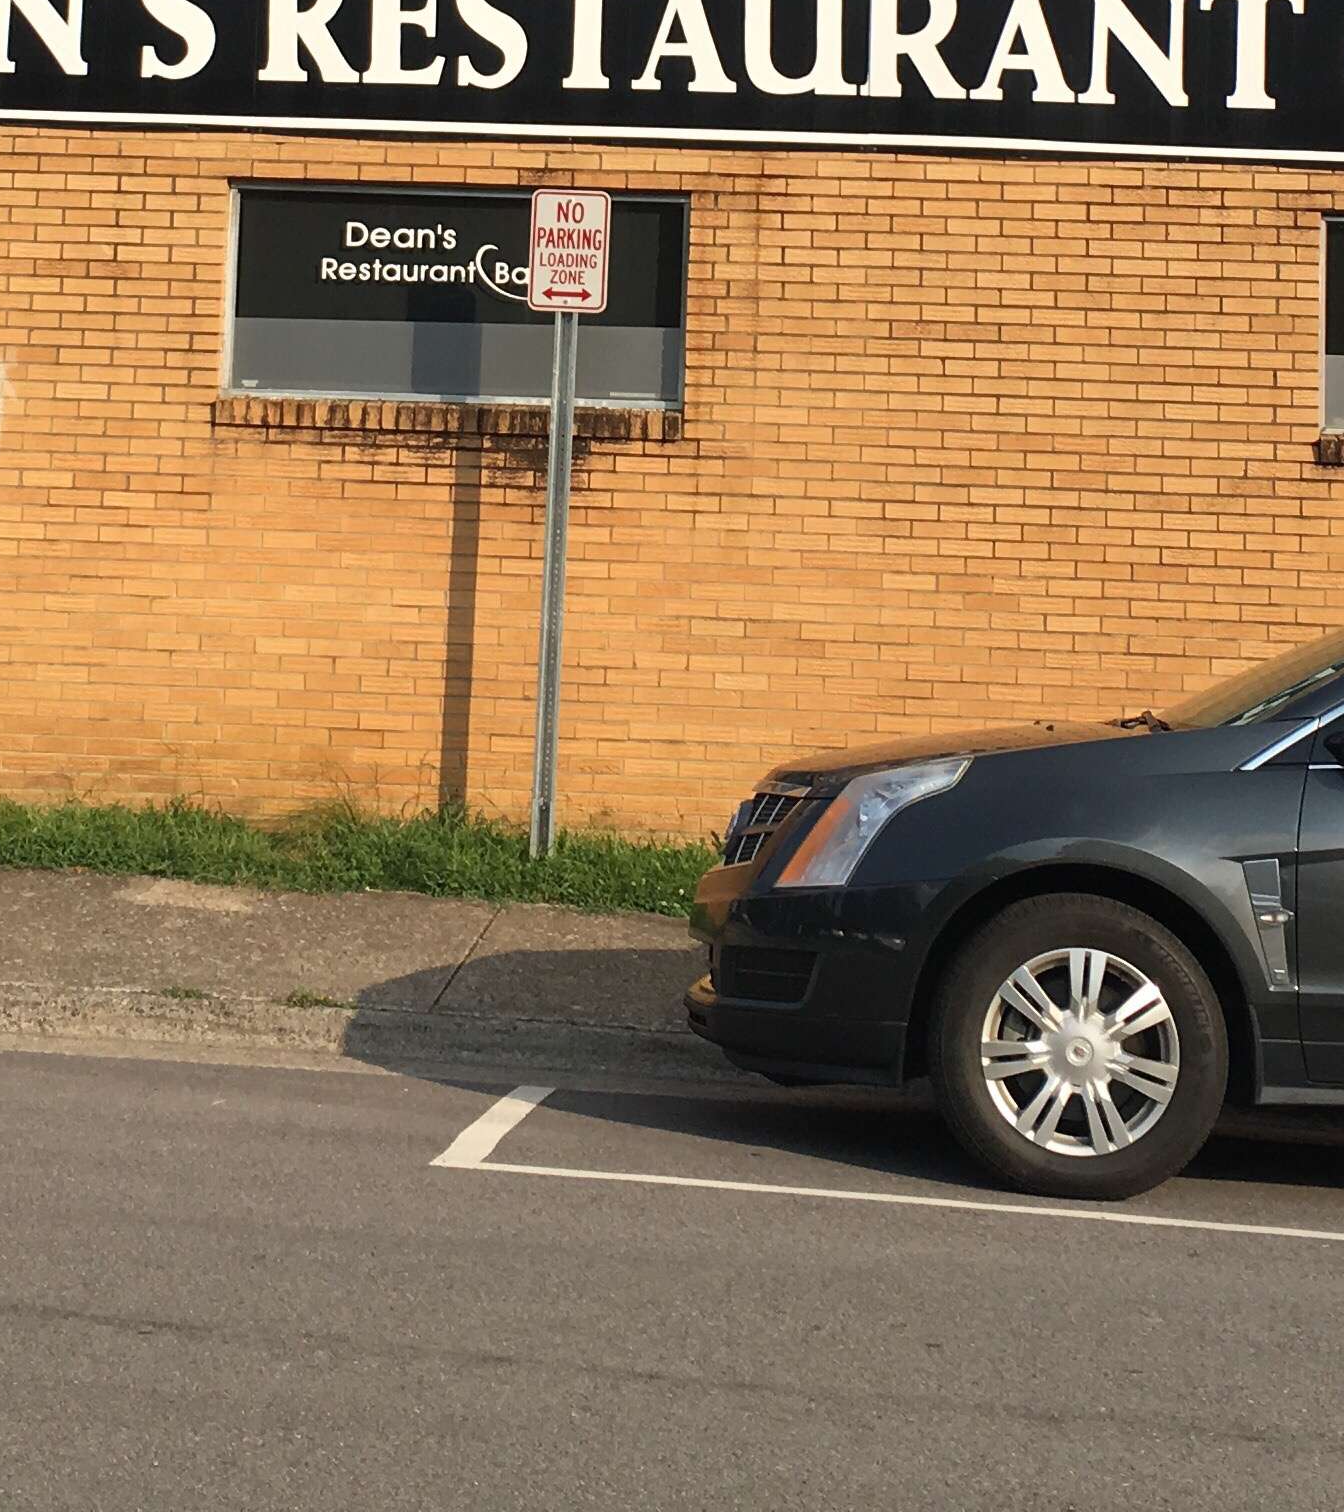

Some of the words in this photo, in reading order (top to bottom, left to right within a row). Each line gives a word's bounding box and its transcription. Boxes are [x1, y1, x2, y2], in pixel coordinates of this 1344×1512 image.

[556, 200, 585, 224] NO
[346, 221, 457, 250] Dean's
[536, 226, 603, 251] PARKING
[322, 257, 477, 284] Restaurant
[539, 252, 598, 269] LOADING
[549, 269, 586, 286] ZONE
